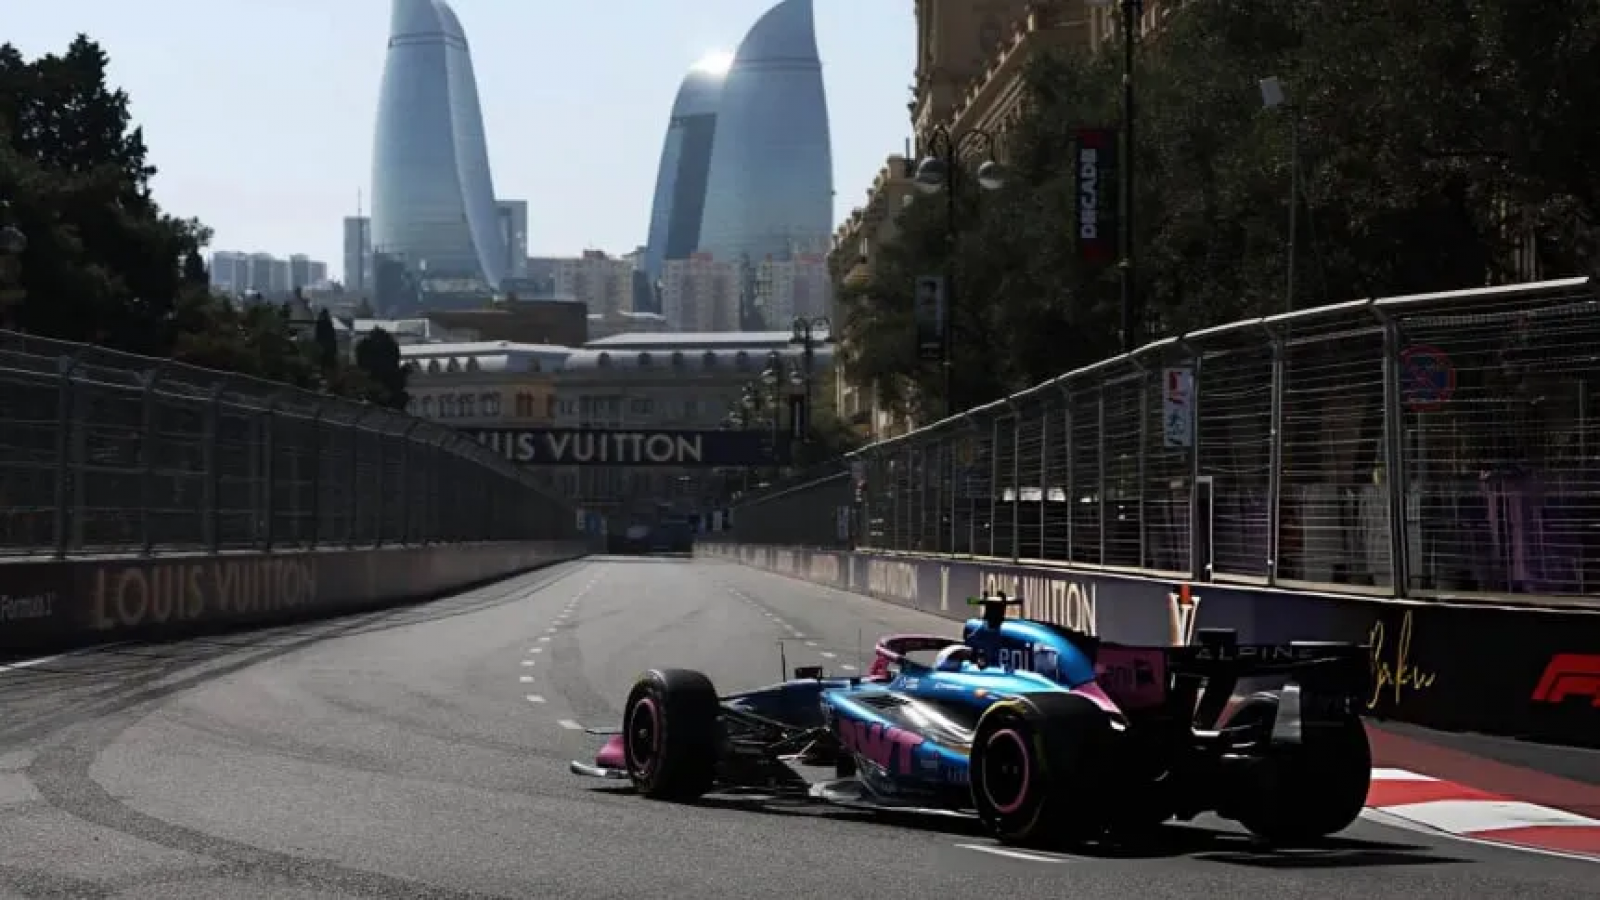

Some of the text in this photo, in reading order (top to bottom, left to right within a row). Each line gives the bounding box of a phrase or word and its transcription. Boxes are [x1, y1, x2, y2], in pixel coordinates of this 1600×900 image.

[1081, 148, 1098, 239] DECADE
[546, 433, 703, 462] VUITTON
[92, 557, 317, 630] LOUIS VUITTON
[1195, 643, 1314, 662] ALPINE
